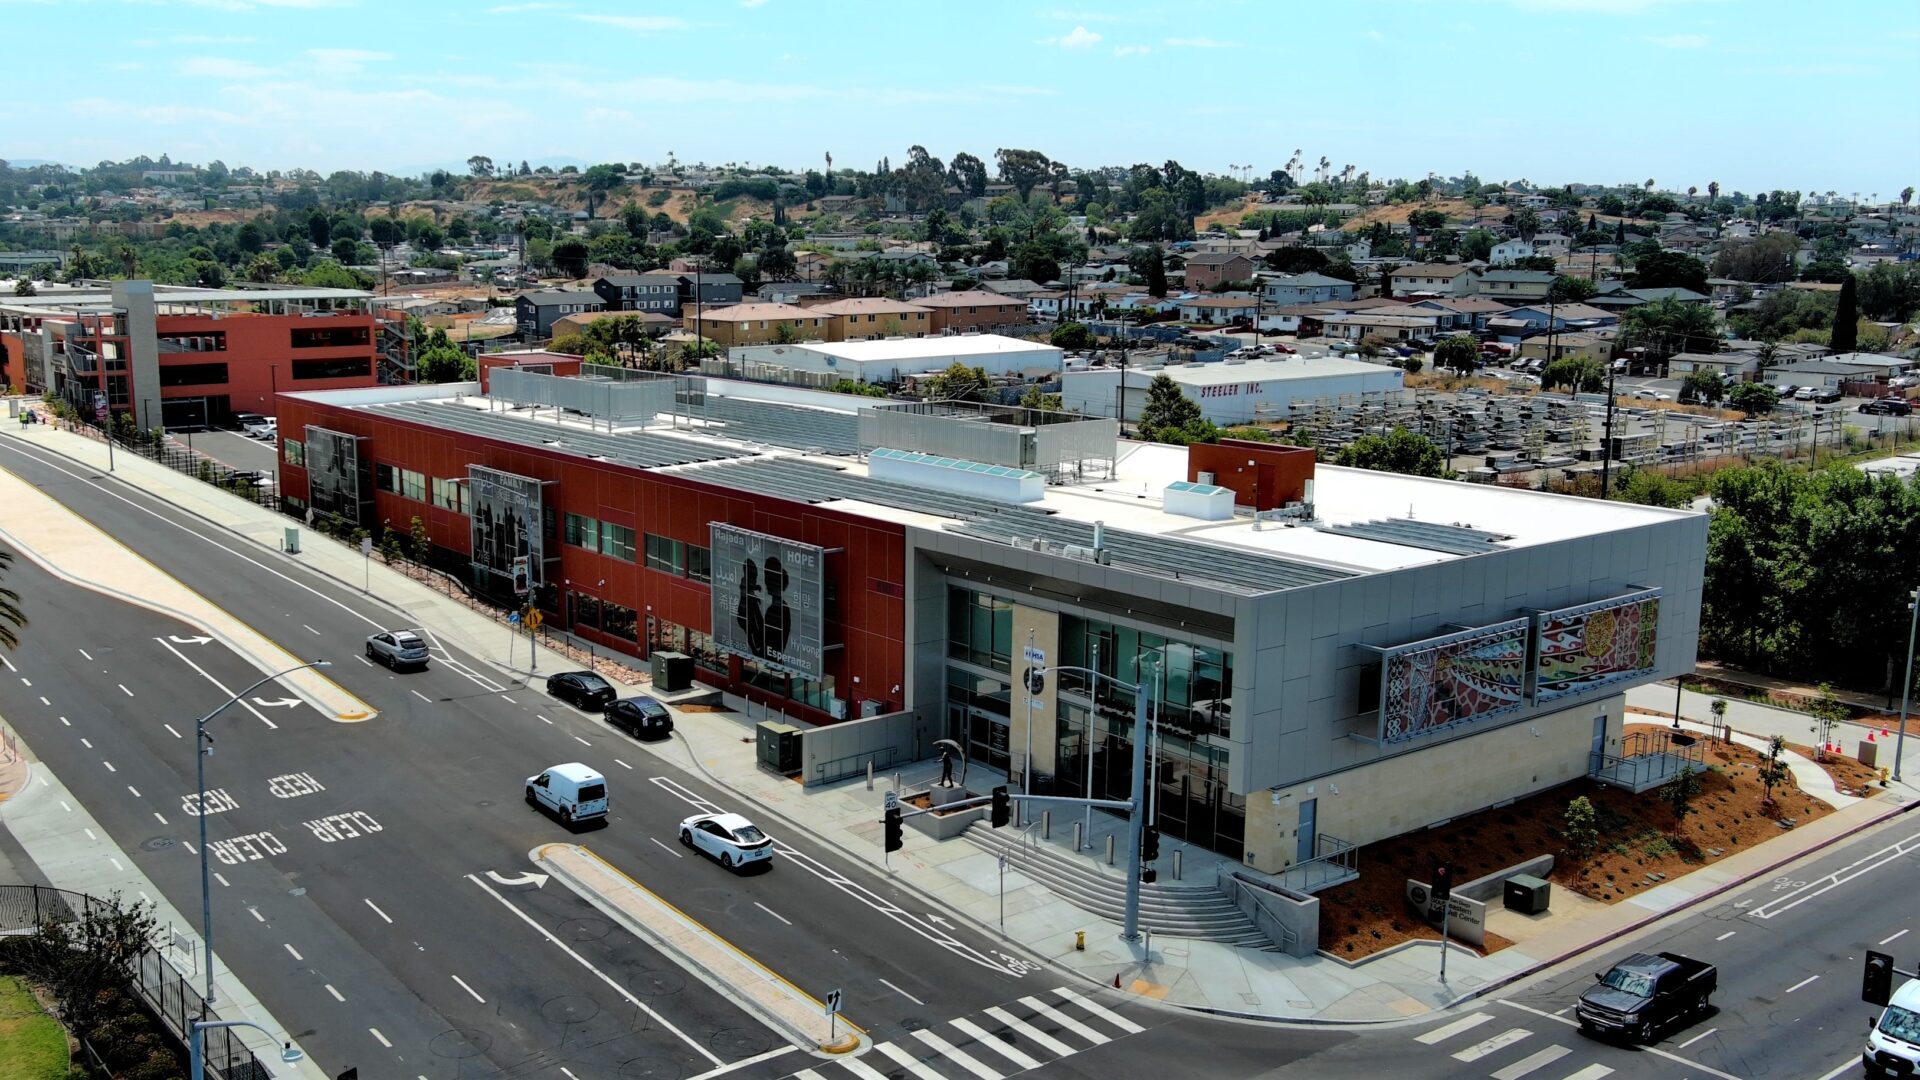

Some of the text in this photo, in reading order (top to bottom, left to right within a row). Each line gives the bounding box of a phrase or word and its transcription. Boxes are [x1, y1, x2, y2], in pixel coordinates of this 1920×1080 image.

[1201, 383, 1262, 397] STEELER INC.
[500, 476, 522, 489] FAMILY
[714, 530, 744, 545] Rajada
[787, 551, 815, 567] HOPE
[766, 646, 812, 669] Esperanza
[267, 772, 326, 799] KEEP
[181, 788, 240, 817] KEEP
[302, 811, 384, 842] CLEAR
[206, 831, 288, 865] CLEAR
[1459, 913, 1480, 925] Center
